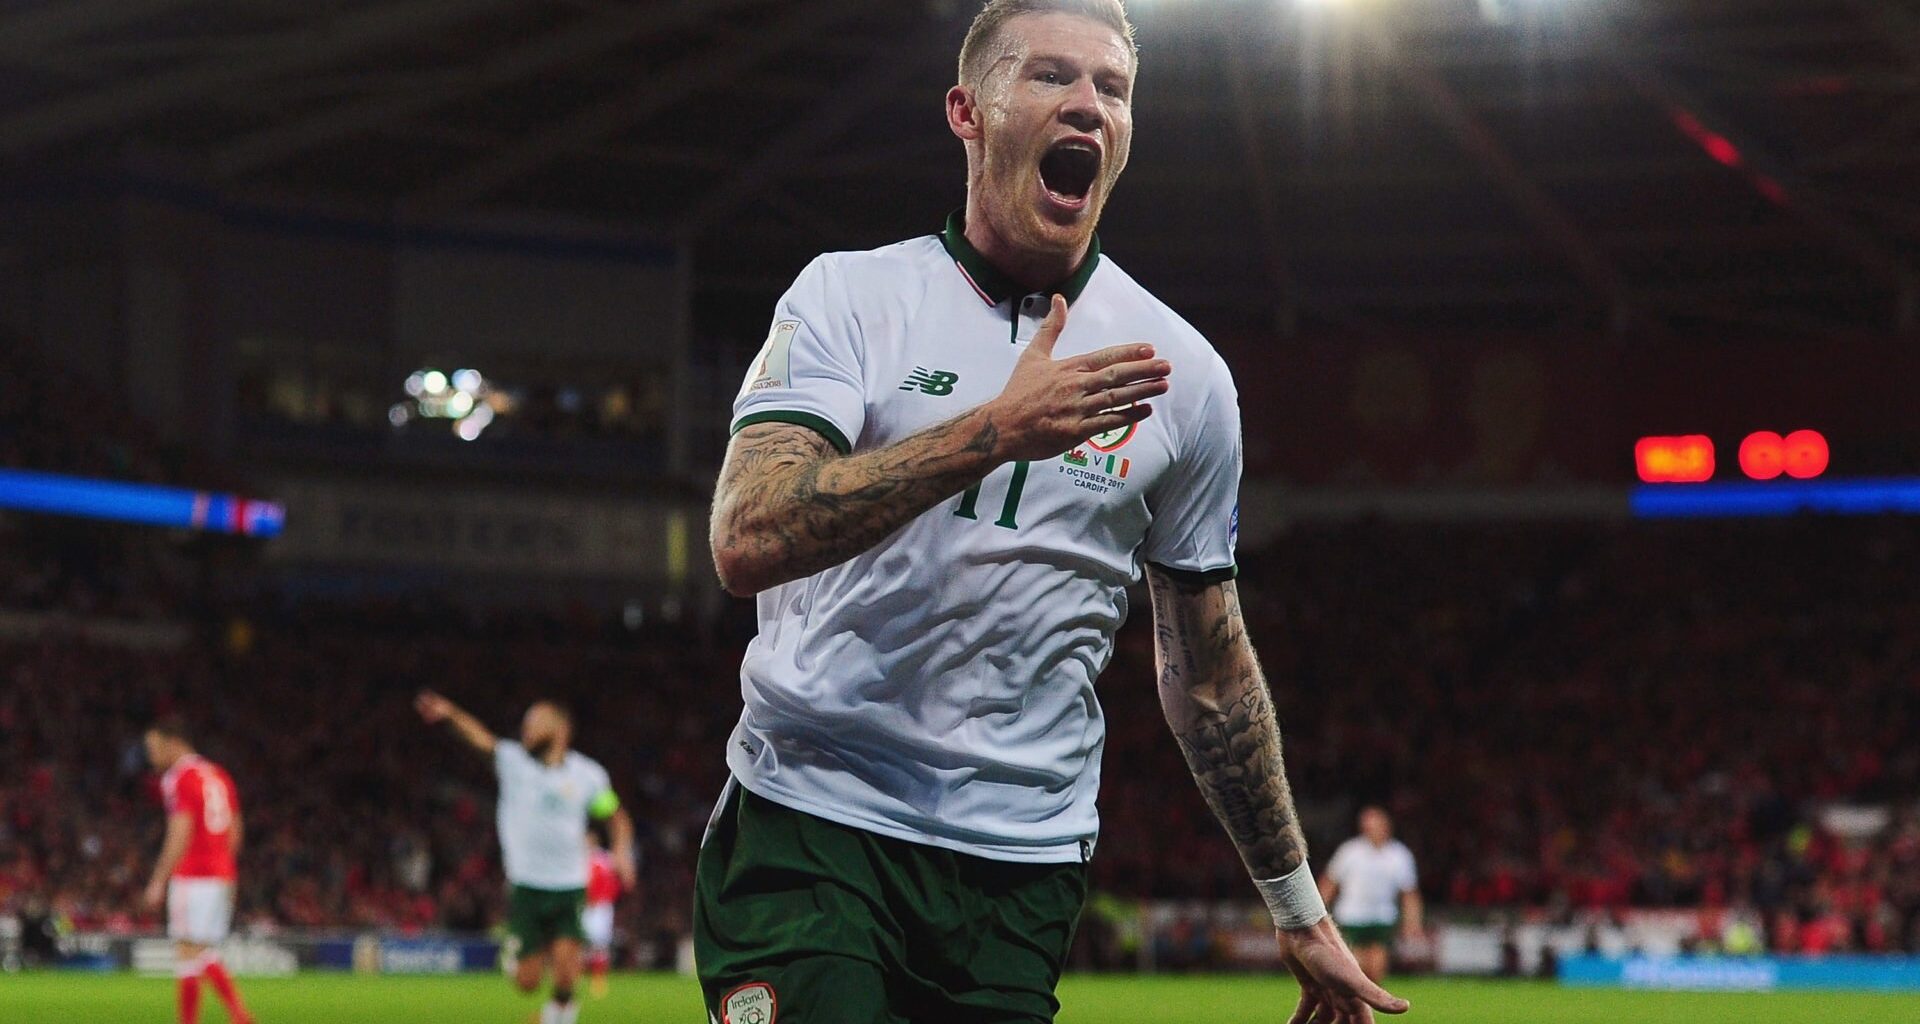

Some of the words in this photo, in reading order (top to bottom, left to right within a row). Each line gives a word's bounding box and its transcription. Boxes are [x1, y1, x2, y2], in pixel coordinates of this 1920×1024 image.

[1059, 465, 1065, 473] 9
[1066, 467, 1106, 484] OCTOBER
[1108, 478, 1126, 490] 2017
[1074, 479, 1109, 494] CARDIFF
[731, 990, 764, 1009] Ireland
